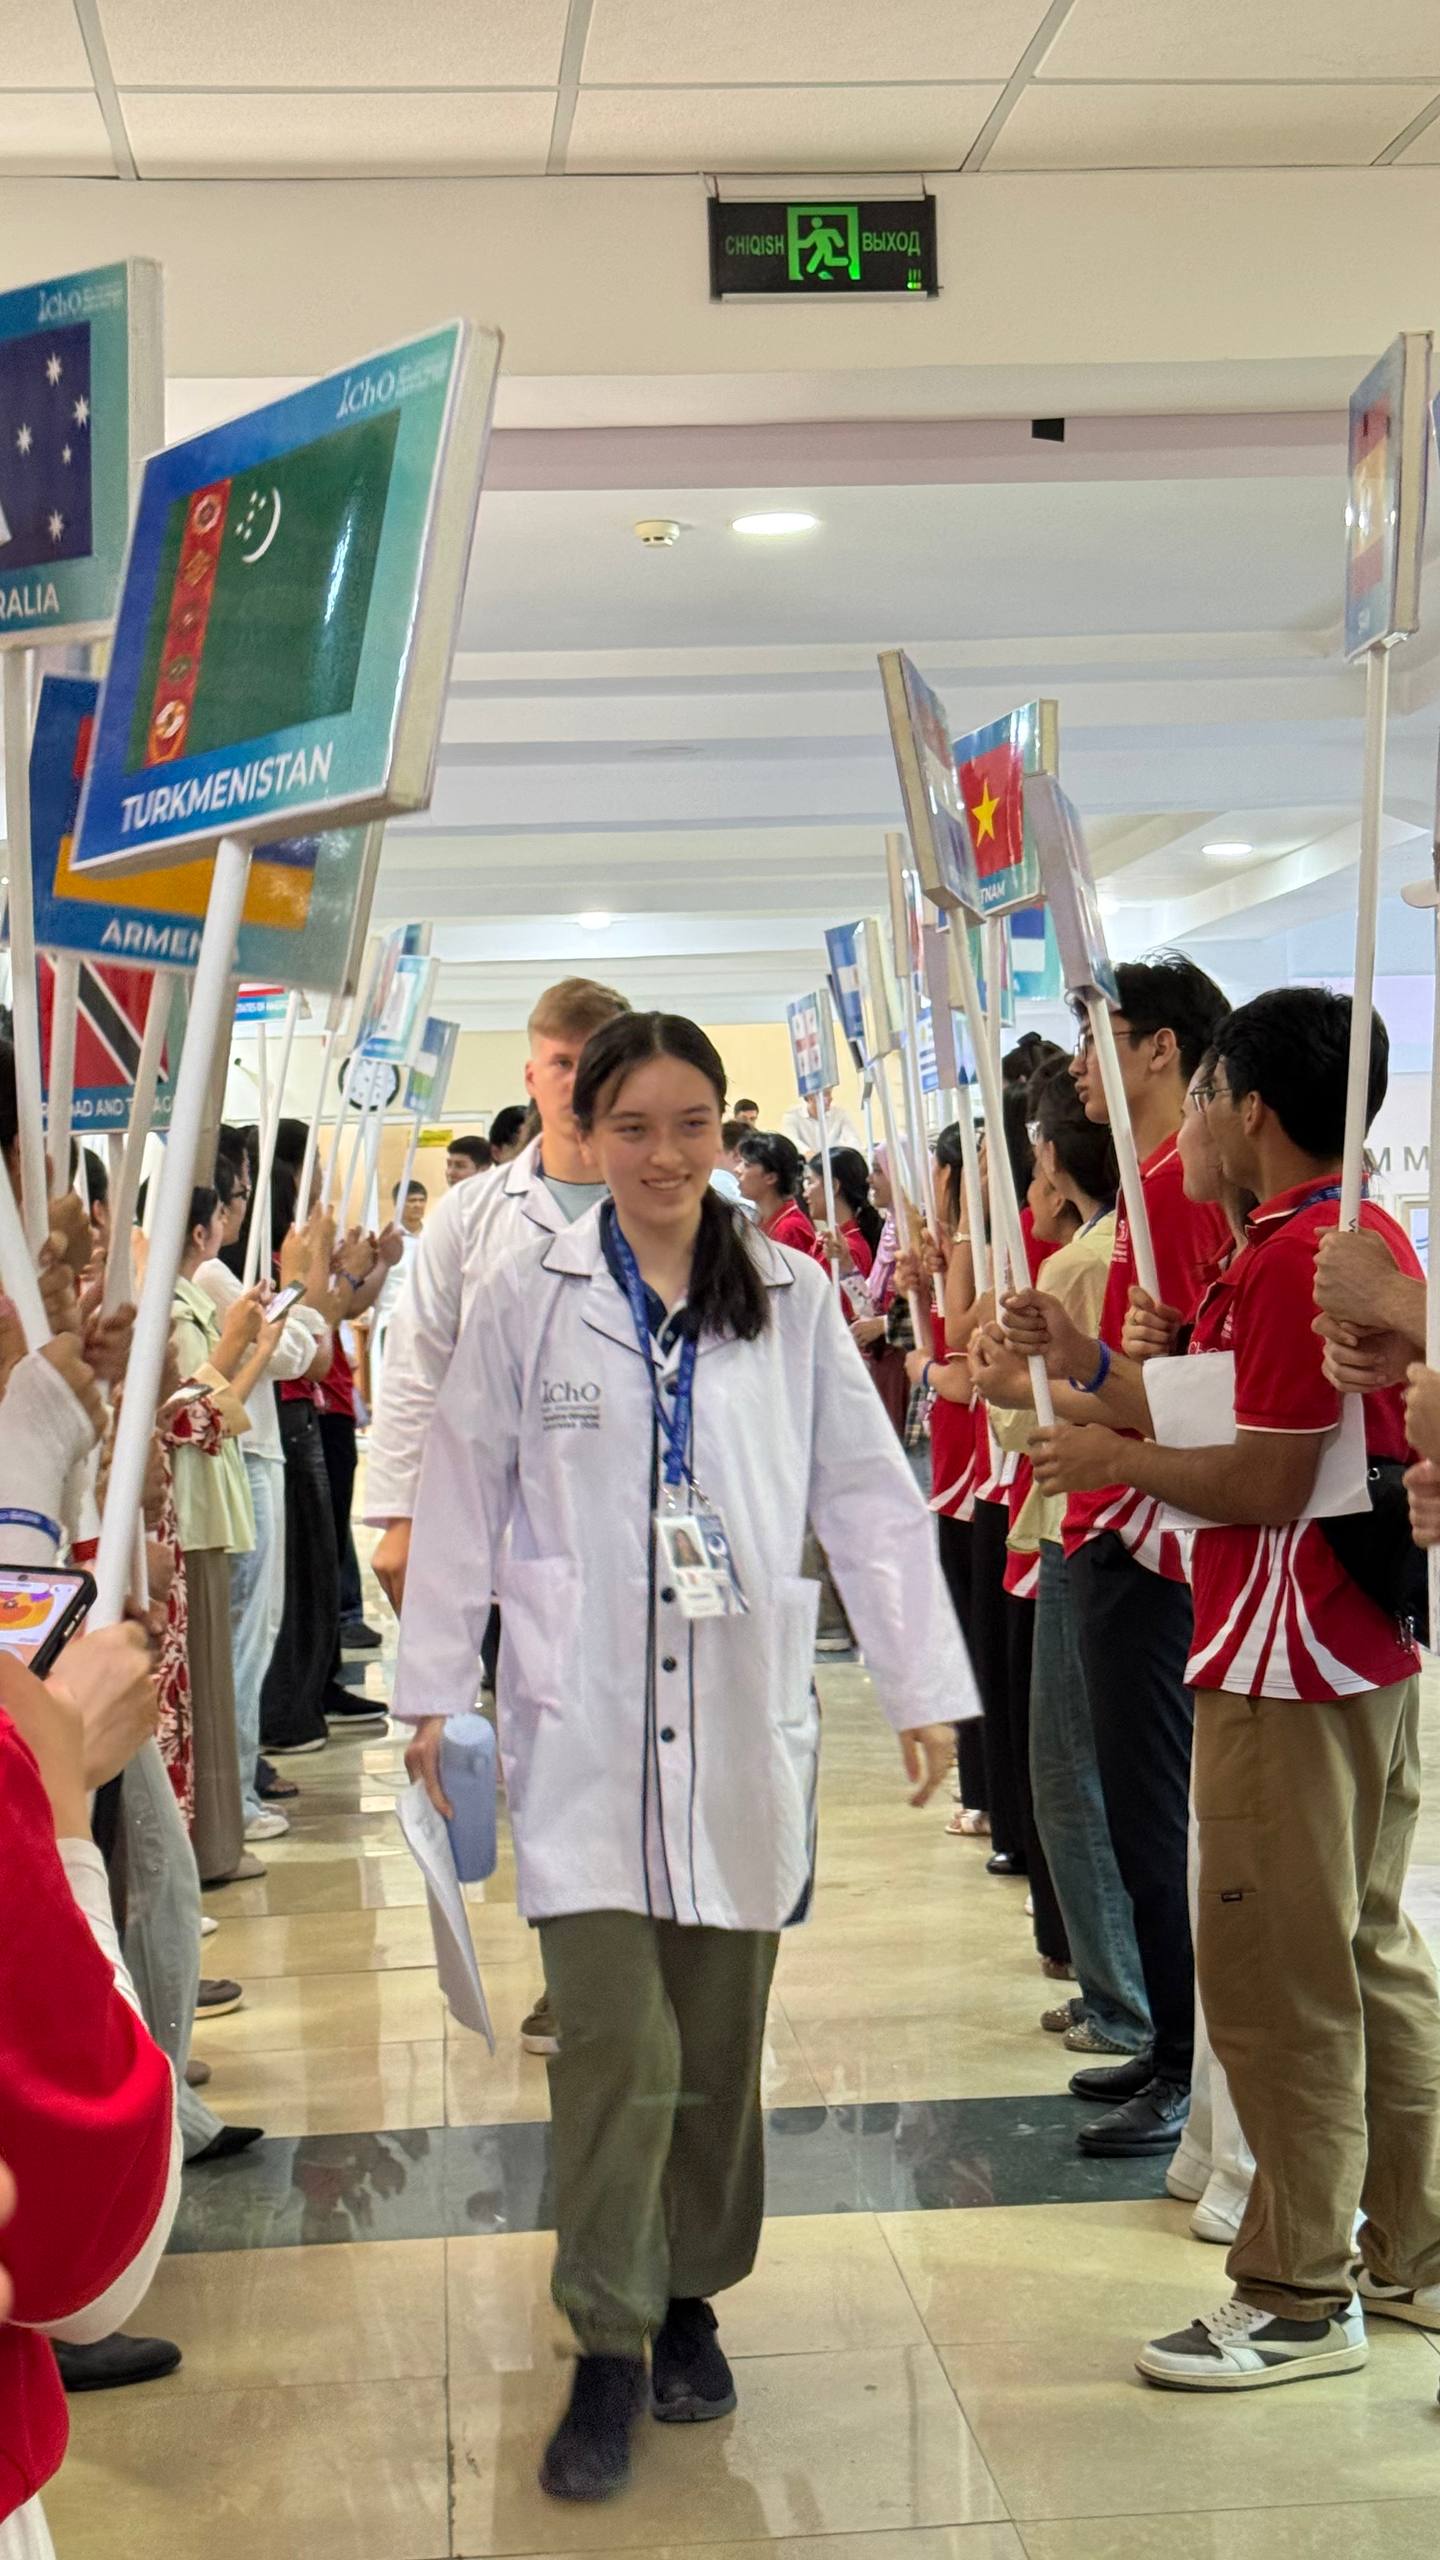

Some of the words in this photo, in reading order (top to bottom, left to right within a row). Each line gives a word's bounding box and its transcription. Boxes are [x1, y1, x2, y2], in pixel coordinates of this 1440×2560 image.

[725, 235, 784, 256] CHIQISH
[862, 231, 921, 256] ВЫХОД
[121, 741, 333, 833] TURKMENISTAN
[543, 1380, 601, 1403] IChO
